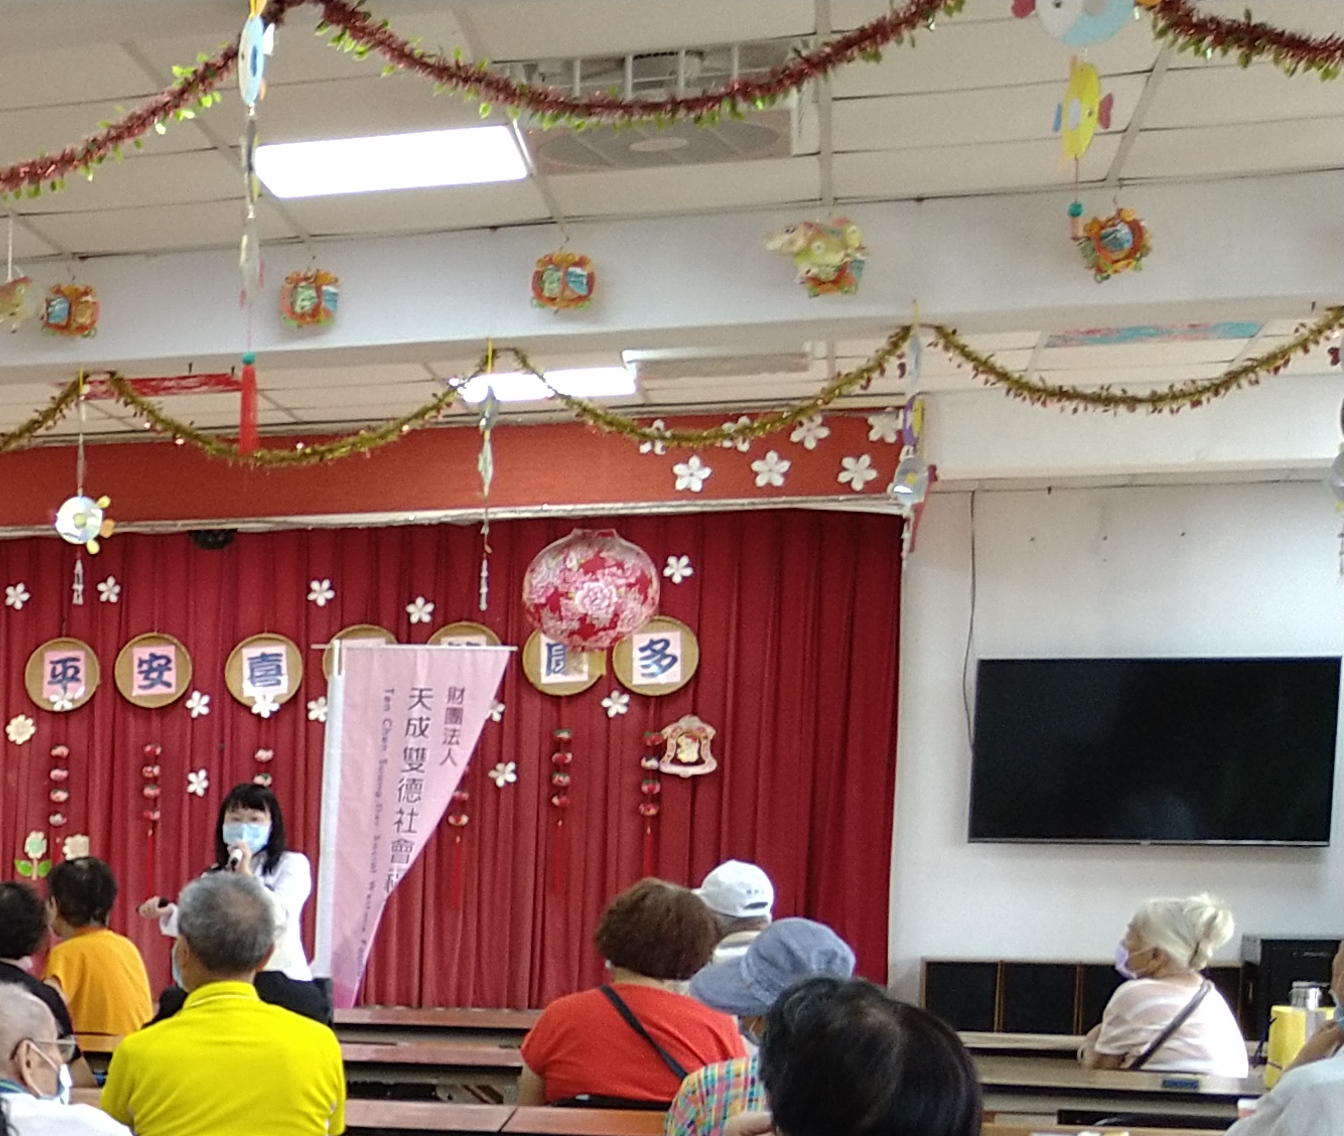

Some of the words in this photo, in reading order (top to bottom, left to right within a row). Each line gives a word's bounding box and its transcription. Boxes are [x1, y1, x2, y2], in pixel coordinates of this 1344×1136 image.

[383, 687, 394, 711] Ten
[381, 718, 393, 751] Chen
[439, 686, 465, 767] 財團法人
